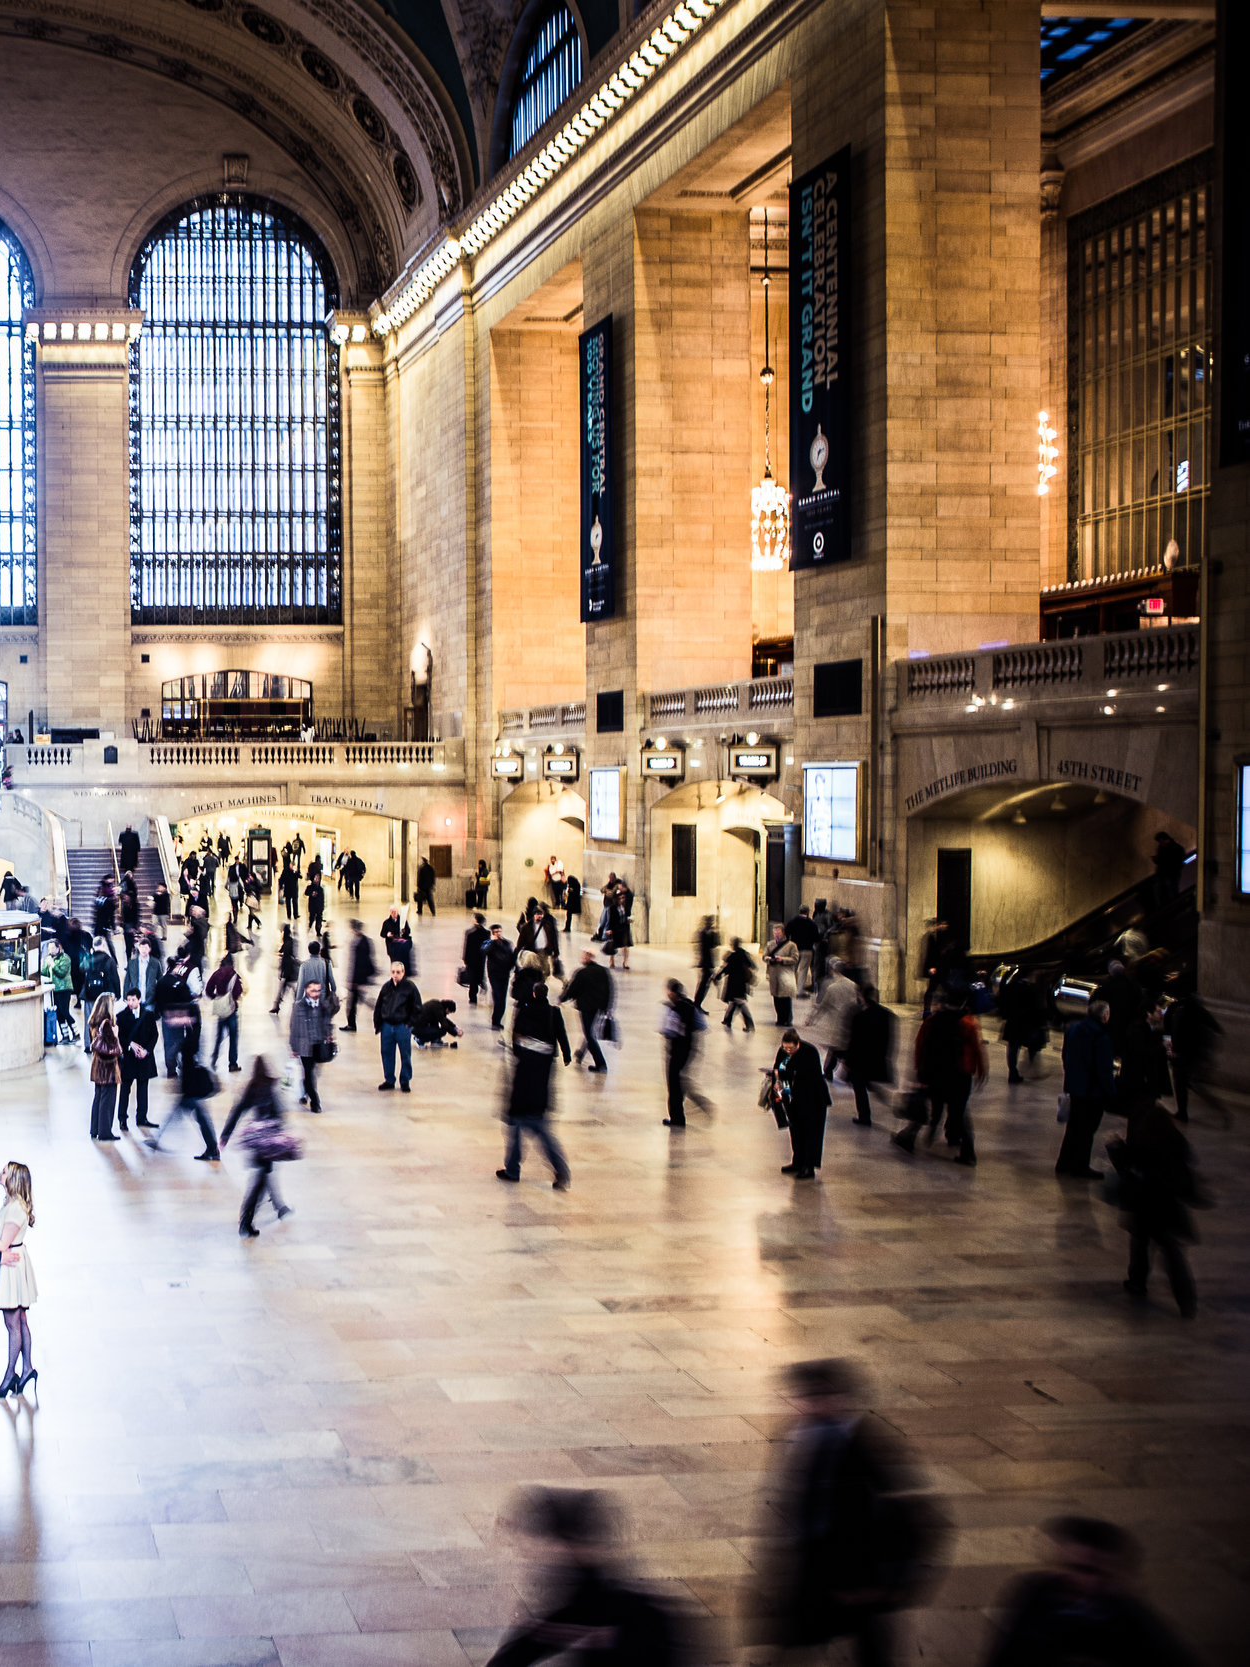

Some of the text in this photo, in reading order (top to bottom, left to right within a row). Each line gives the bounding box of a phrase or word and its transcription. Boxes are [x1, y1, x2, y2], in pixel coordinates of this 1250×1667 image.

[801, 184, 814, 415] ISN'T IT GRAND
[813, 175, 826, 388] CELEBRATION
[826, 170, 839, 391] A CENTENNIAL
[598, 332, 607, 499] GRAND CENTRAL
[591, 423, 600, 451] US
[591, 454, 600, 495] FOR
[798, 488, 840, 507] GRAND CENTRAL
[904, 758, 1018, 811] THE METLIFE BUILDING
[1058, 760, 1142, 792] 45TH STREET
[191, 794, 277, 814] TICKET MACHINES
[310, 793, 347, 805] TRACKS
[360, 799, 372, 809] TO
